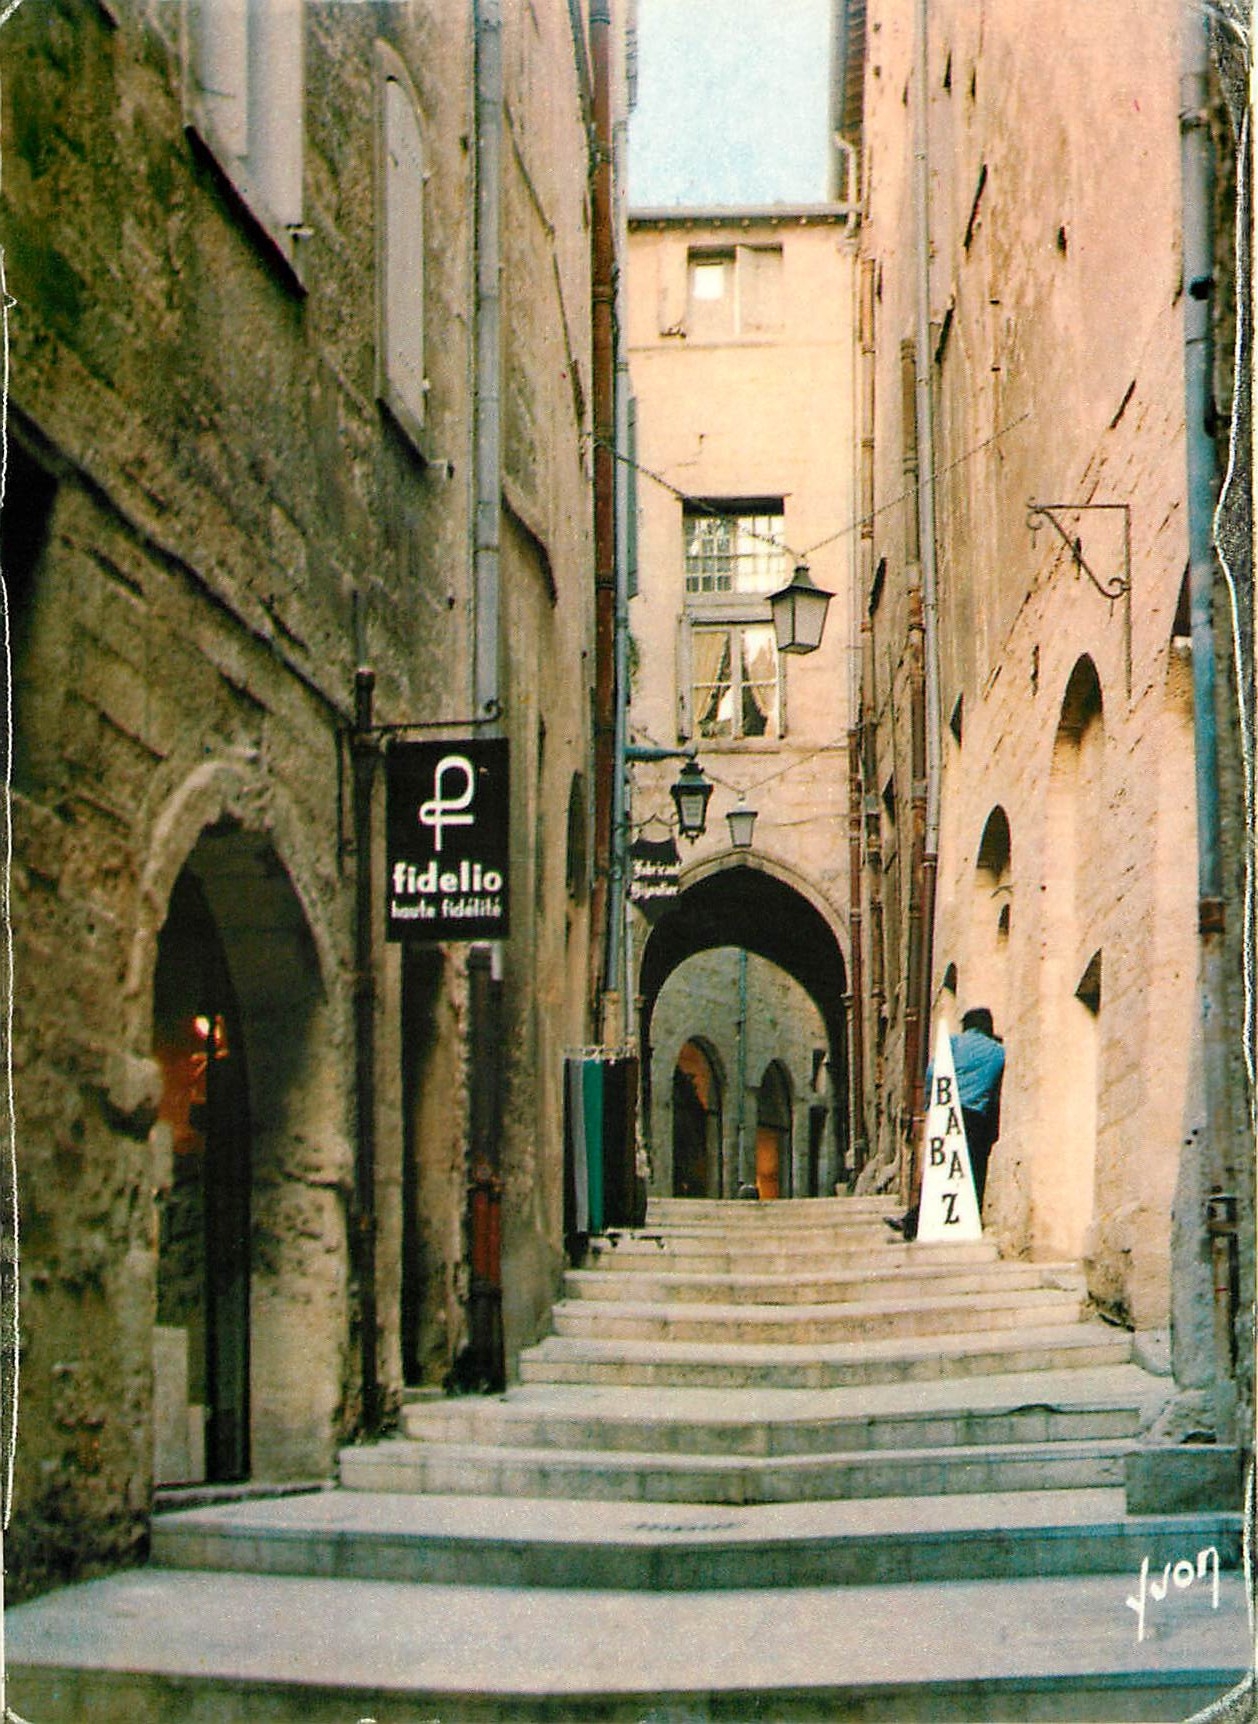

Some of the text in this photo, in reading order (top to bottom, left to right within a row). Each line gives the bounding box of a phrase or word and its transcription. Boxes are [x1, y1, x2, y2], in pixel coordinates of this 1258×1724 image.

[393, 860, 502, 894] fidelio
[391, 897, 501, 919] haute fidélité
[930, 1077, 964, 1225] BABAZ
